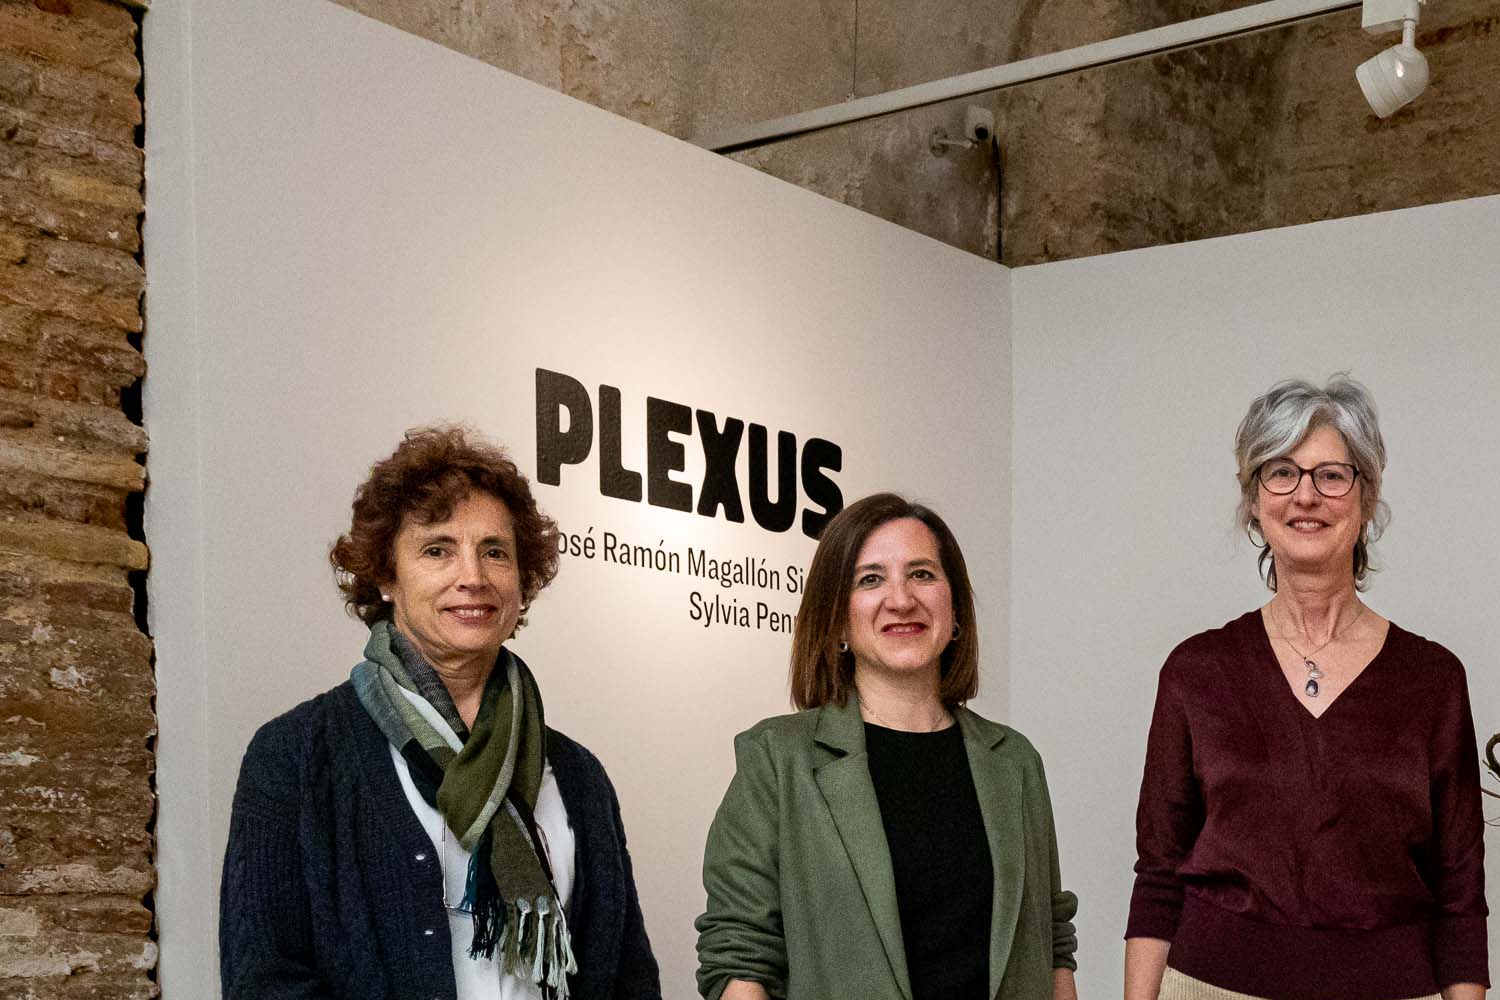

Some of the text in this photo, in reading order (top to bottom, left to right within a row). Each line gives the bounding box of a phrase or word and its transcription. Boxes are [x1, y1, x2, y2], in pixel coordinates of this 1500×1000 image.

[535, 367, 844, 542] PLEXUS
[558, 526, 803, 594] osé Ramón Magallón Si
[689, 591, 797, 634] Sylvia Pen
